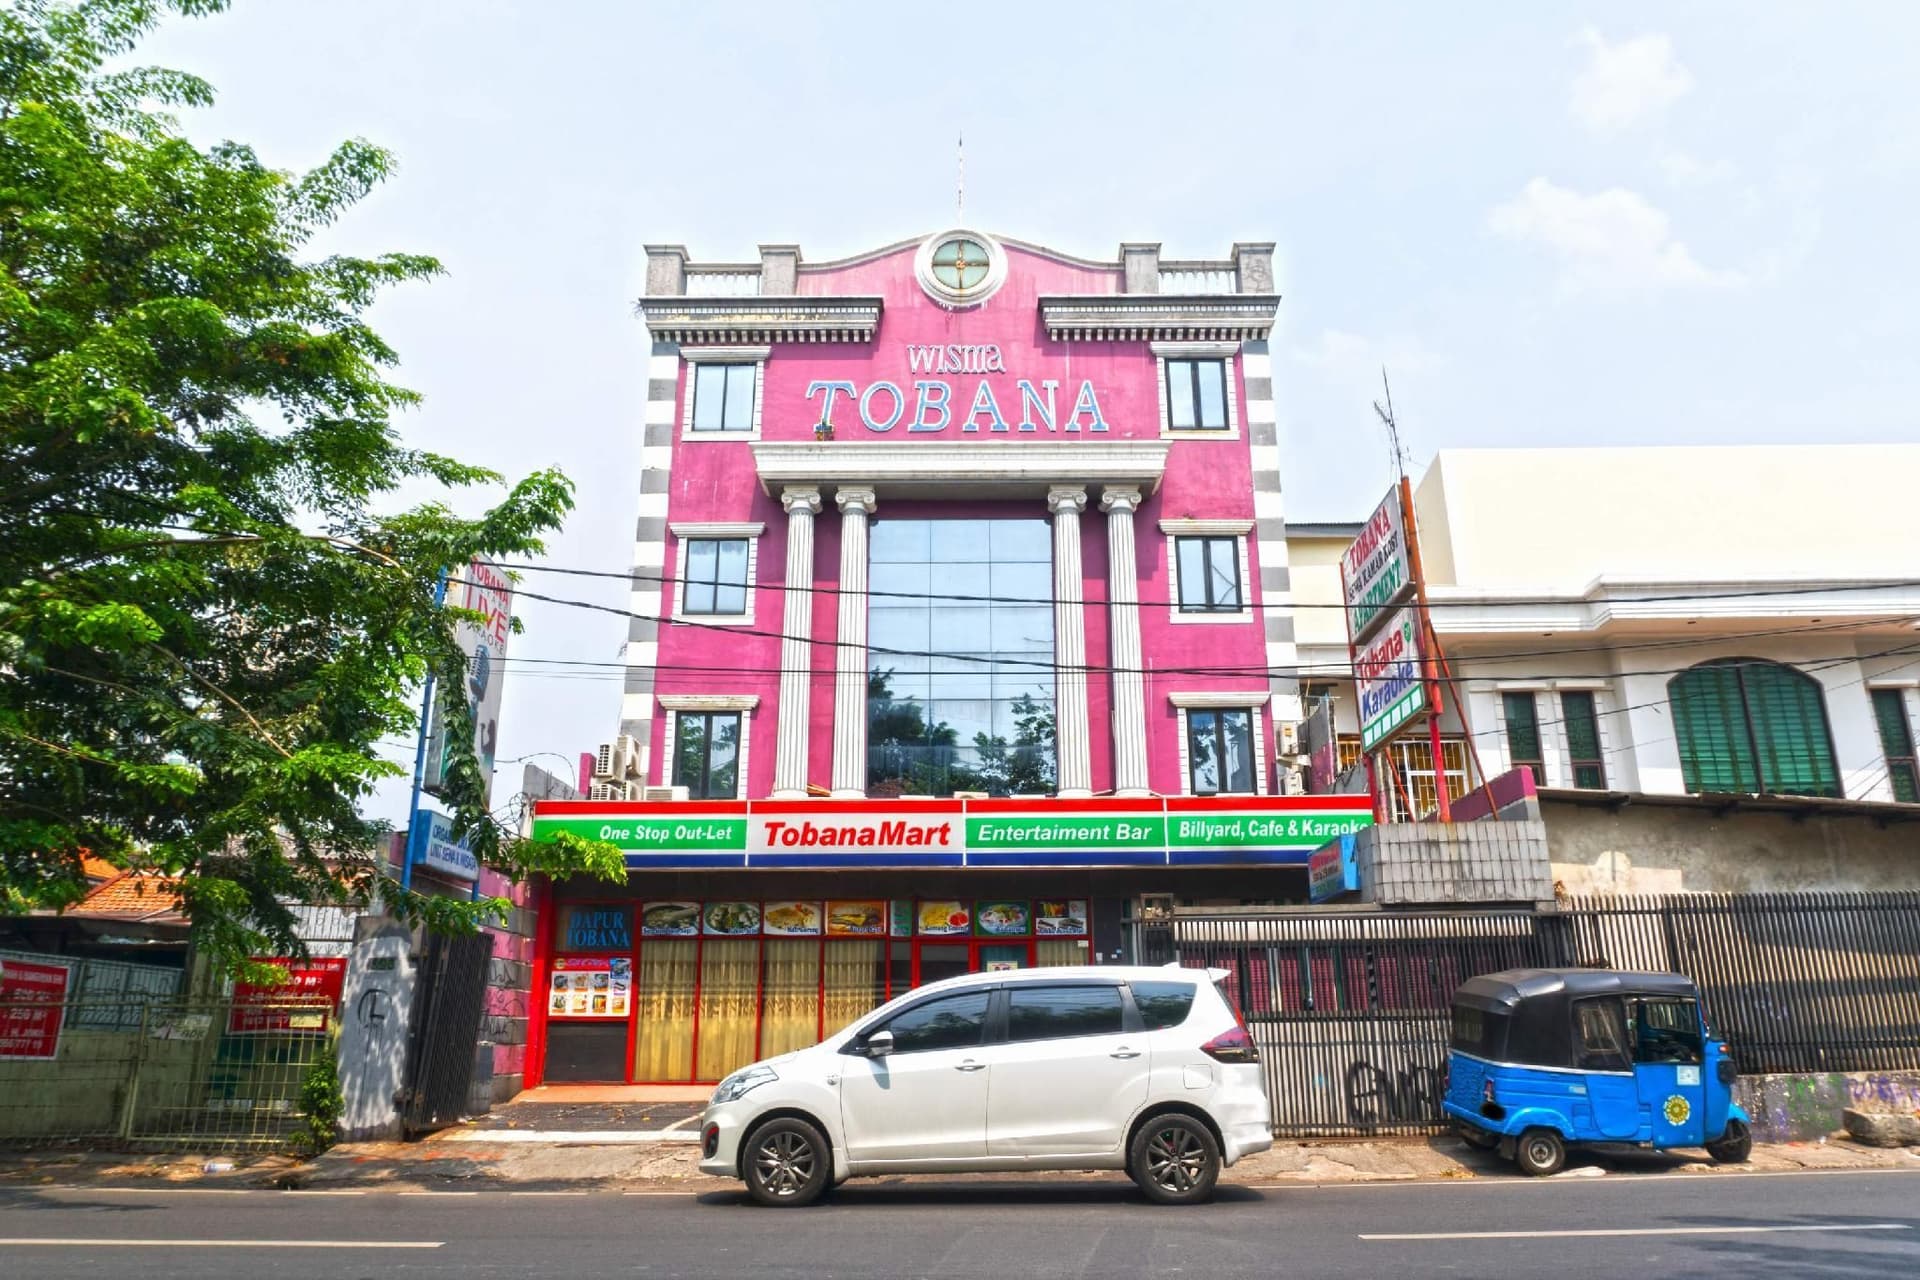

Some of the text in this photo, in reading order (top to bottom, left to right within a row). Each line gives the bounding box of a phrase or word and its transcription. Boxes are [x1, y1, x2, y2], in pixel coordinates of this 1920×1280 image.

[805, 379, 1109, 432] TOBANA
[1349, 505, 1391, 573] TOBANA
[1354, 556, 1402, 634] APARTMENT
[1356, 629, 1403, 689] Tobana
[1362, 660, 1415, 722] Karaoke
[599, 824, 732, 844] One Stop Out-Let
[763, 821, 951, 847] TobanaMart
[977, 823, 1153, 842] Entertaiment Bar
[1178, 820, 1246, 843] Billyard,
[1247, 819, 1284, 838] Cafe
[1287, 819, 1299, 837] &
[569, 911, 624, 929] DAPUR
[566, 929, 631, 947] TOBANA
